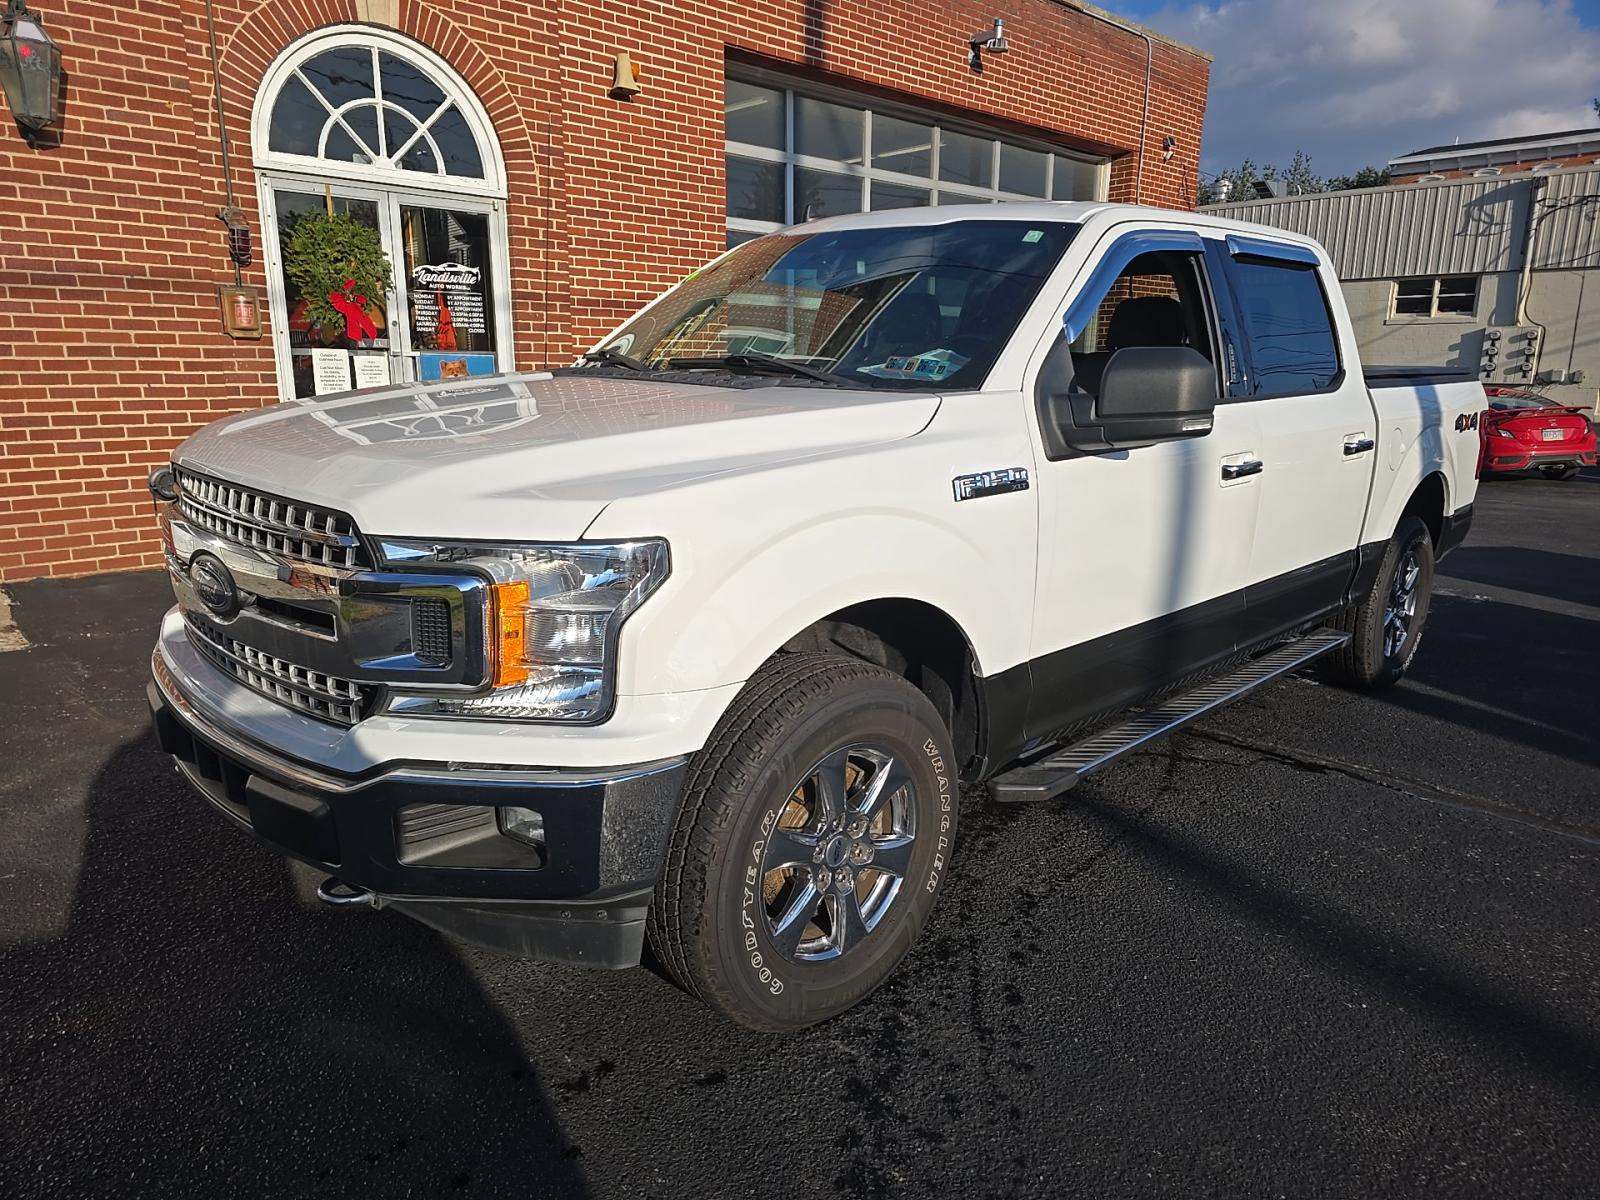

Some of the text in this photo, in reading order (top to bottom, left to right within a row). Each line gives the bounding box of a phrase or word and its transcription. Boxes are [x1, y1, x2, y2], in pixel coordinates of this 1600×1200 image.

[418, 270, 477, 284] Landisville
[922, 738, 951, 894] WRANGLER
[741, 809, 784, 995] GOODYEAR
